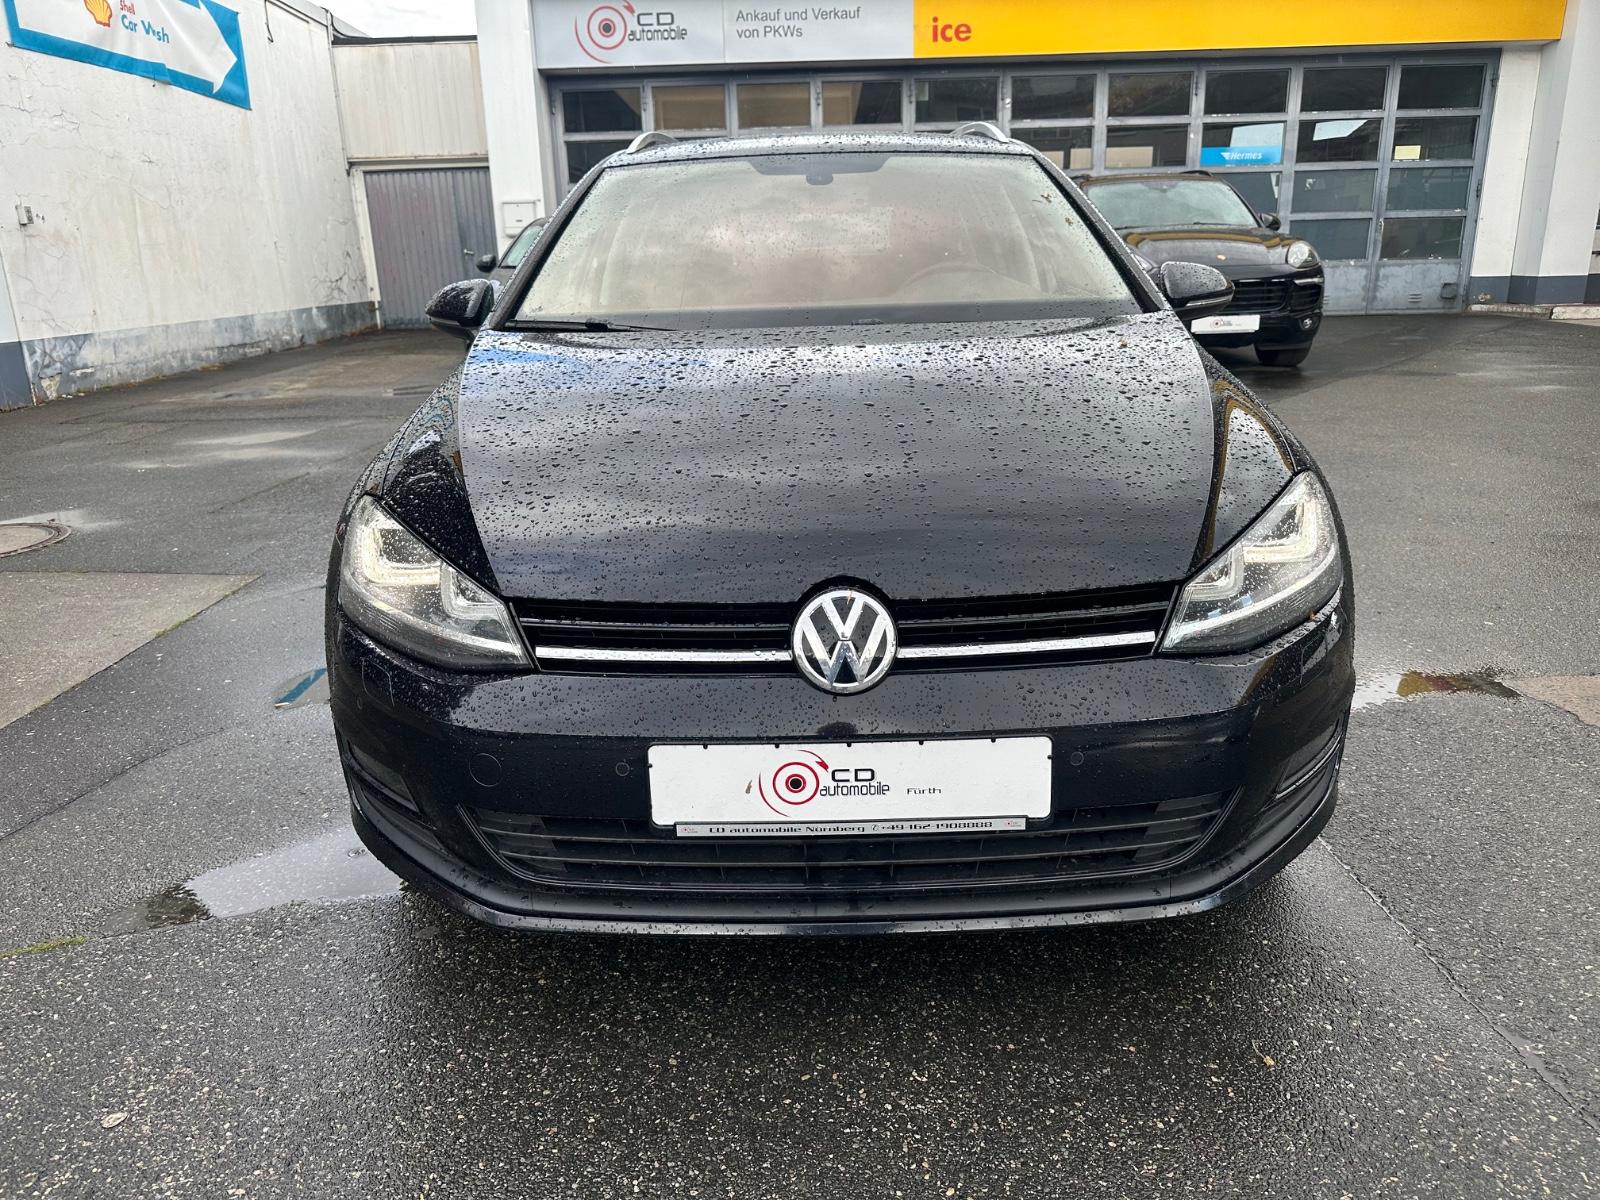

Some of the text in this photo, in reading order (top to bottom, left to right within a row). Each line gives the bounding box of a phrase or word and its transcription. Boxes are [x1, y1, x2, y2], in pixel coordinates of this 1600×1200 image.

[637, 12, 675, 26] CD
[736, 6, 861, 22] Ankauf und Verkauf
[121, 14, 137, 32] Car
[932, 16, 972, 42] ice
[628, 26, 688, 41] automobile
[736, 25, 803, 39] von PKWs
[1230, 152, 1263, 160] Hermes
[831, 768, 875, 782] CD
[819, 781, 890, 797] automobile
[906, 787, 942, 795] Fürth
[805, 825, 865, 833] Nürnberg
